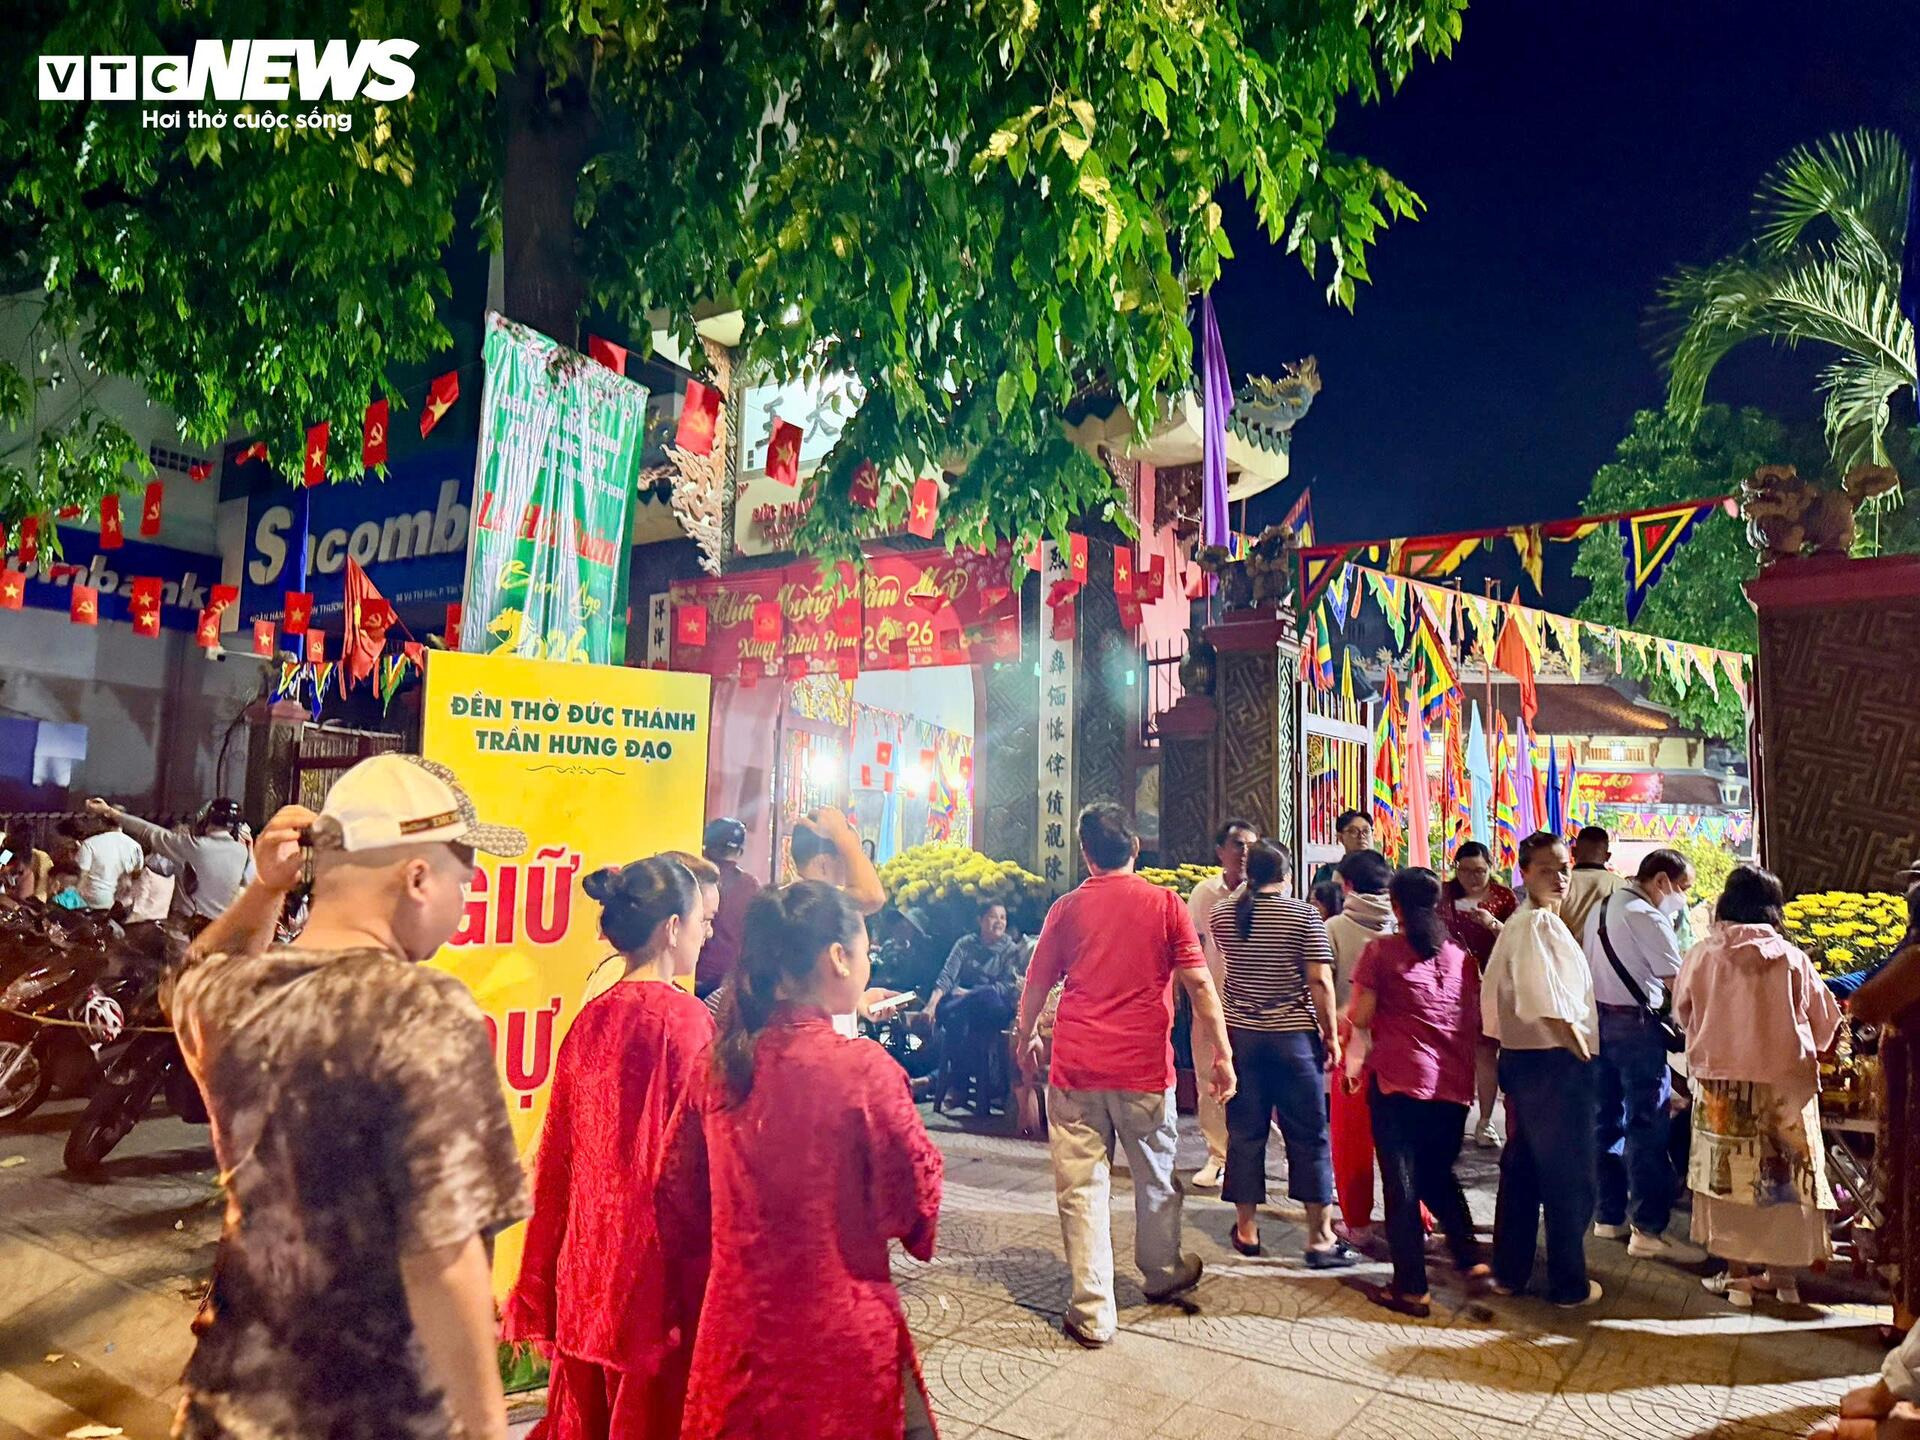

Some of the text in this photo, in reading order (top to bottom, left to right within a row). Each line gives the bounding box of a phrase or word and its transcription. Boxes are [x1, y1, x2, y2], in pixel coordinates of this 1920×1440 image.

[249, 479, 471, 586] Scomb
[451, 690, 696, 731] ĐỀN THỜ ĐỨC THÁNH
[476, 726, 672, 763] TRẦN HƯNG ĐẠO
[483, 997, 562, 1109] Ự
